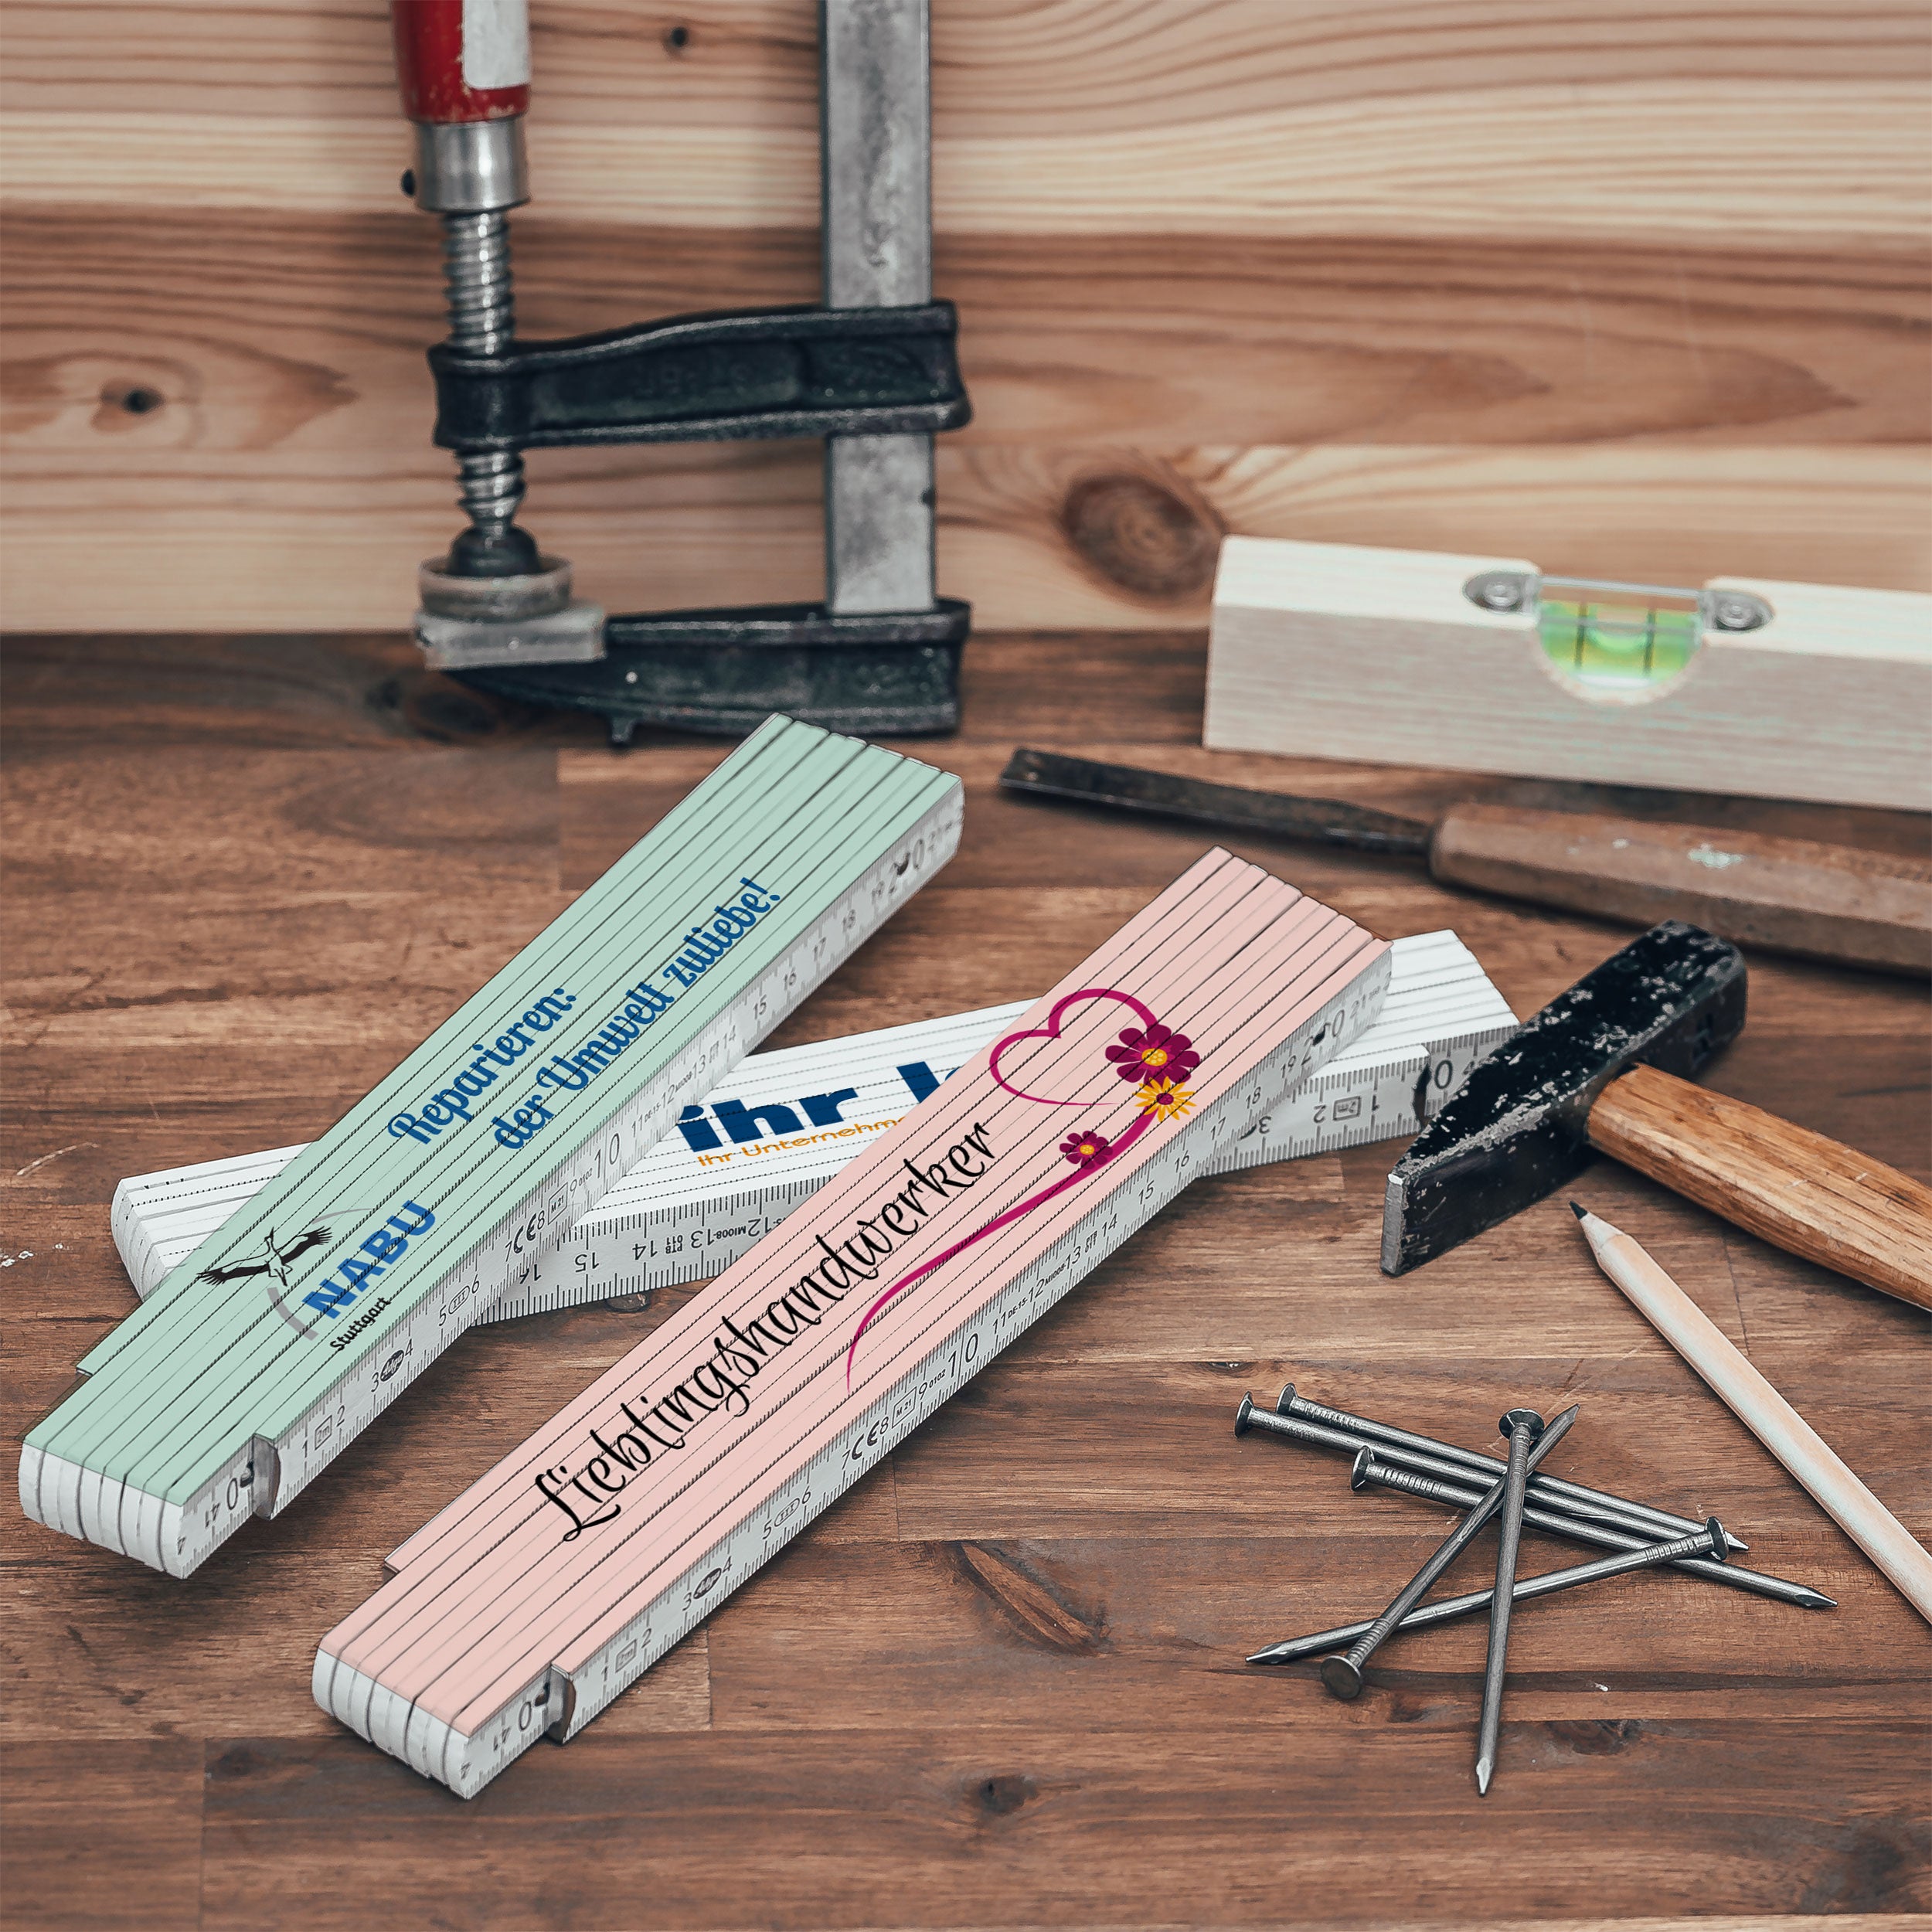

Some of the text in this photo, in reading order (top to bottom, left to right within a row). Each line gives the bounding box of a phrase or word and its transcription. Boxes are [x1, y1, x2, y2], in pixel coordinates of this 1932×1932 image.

[491, 877, 781, 1150] der Umwelt zuliebe!
[387, 987, 577, 1145] Reparieren:
[677, 1087, 858, 1152] ihr
[697, 1116, 905, 1167] Ihr Unternehm
[1259, 1115, 1272, 1134] 3
[1314, 1105, 1326, 1123] 2
[301, 1440, 309, 1458] 1
[336, 1405, 345, 1427] 2
[371, 1372, 379, 1393] 3
[404, 1338, 413, 1357] 4
[438, 1304, 447, 1327] 5
[471, 1274, 480, 1294] 6
[505, 1240, 513, 1262] 7
[537, 1210, 545, 1230] 8
[570, 1179, 578, 1199] 9
[594, 1132, 620, 1179] 10
[631, 1114, 643, 1138] 11
[661, 1083, 675, 1108] 12
[692, 1053, 706, 1079] 13
[723, 1025, 736, 1049] 14
[753, 995, 767, 1019] 15
[783, 968, 797, 991] 16
[813, 937, 827, 961] 17
[632, 1243, 657, 1261] 14
[690, 1228, 715, 1249] 13
[748, 1216, 772, 1237] 12
[302, 1200, 435, 1320] NABU
[574, 1252, 600, 1274] 15
[329, 1296, 393, 1352] Stuttgart
[535, 1121, 995, 1543] Lieblingshandwerker
[601, 1665, 608, 1682] 1
[641, 1628, 652, 1648] 2
[682, 1592, 692, 1611] 3
[722, 1556, 733, 1573] 4
[762, 1519, 772, 1540] 5
[801, 1485, 811, 1505] 6
[842, 1450, 851, 1470] 7
[879, 1417, 889, 1435] 8
[918, 1382, 927, 1400] 9
[928, 1369, 946, 1389] 0102
[948, 1332, 978, 1378] 10
[992, 1311, 1006, 1335] 11
[1028, 1278, 1044, 1302] 12
[1066, 1246, 1081, 1270] 13
[1102, 1213, 1117, 1237] 14
[1138, 1180, 1154, 1205] 15
[1174, 1150, 1190, 1173] 16
[1210, 1116, 1226, 1141] 17
[1246, 1086, 1261, 1109] 18
[1281, 1055, 1297, 1079] 19
